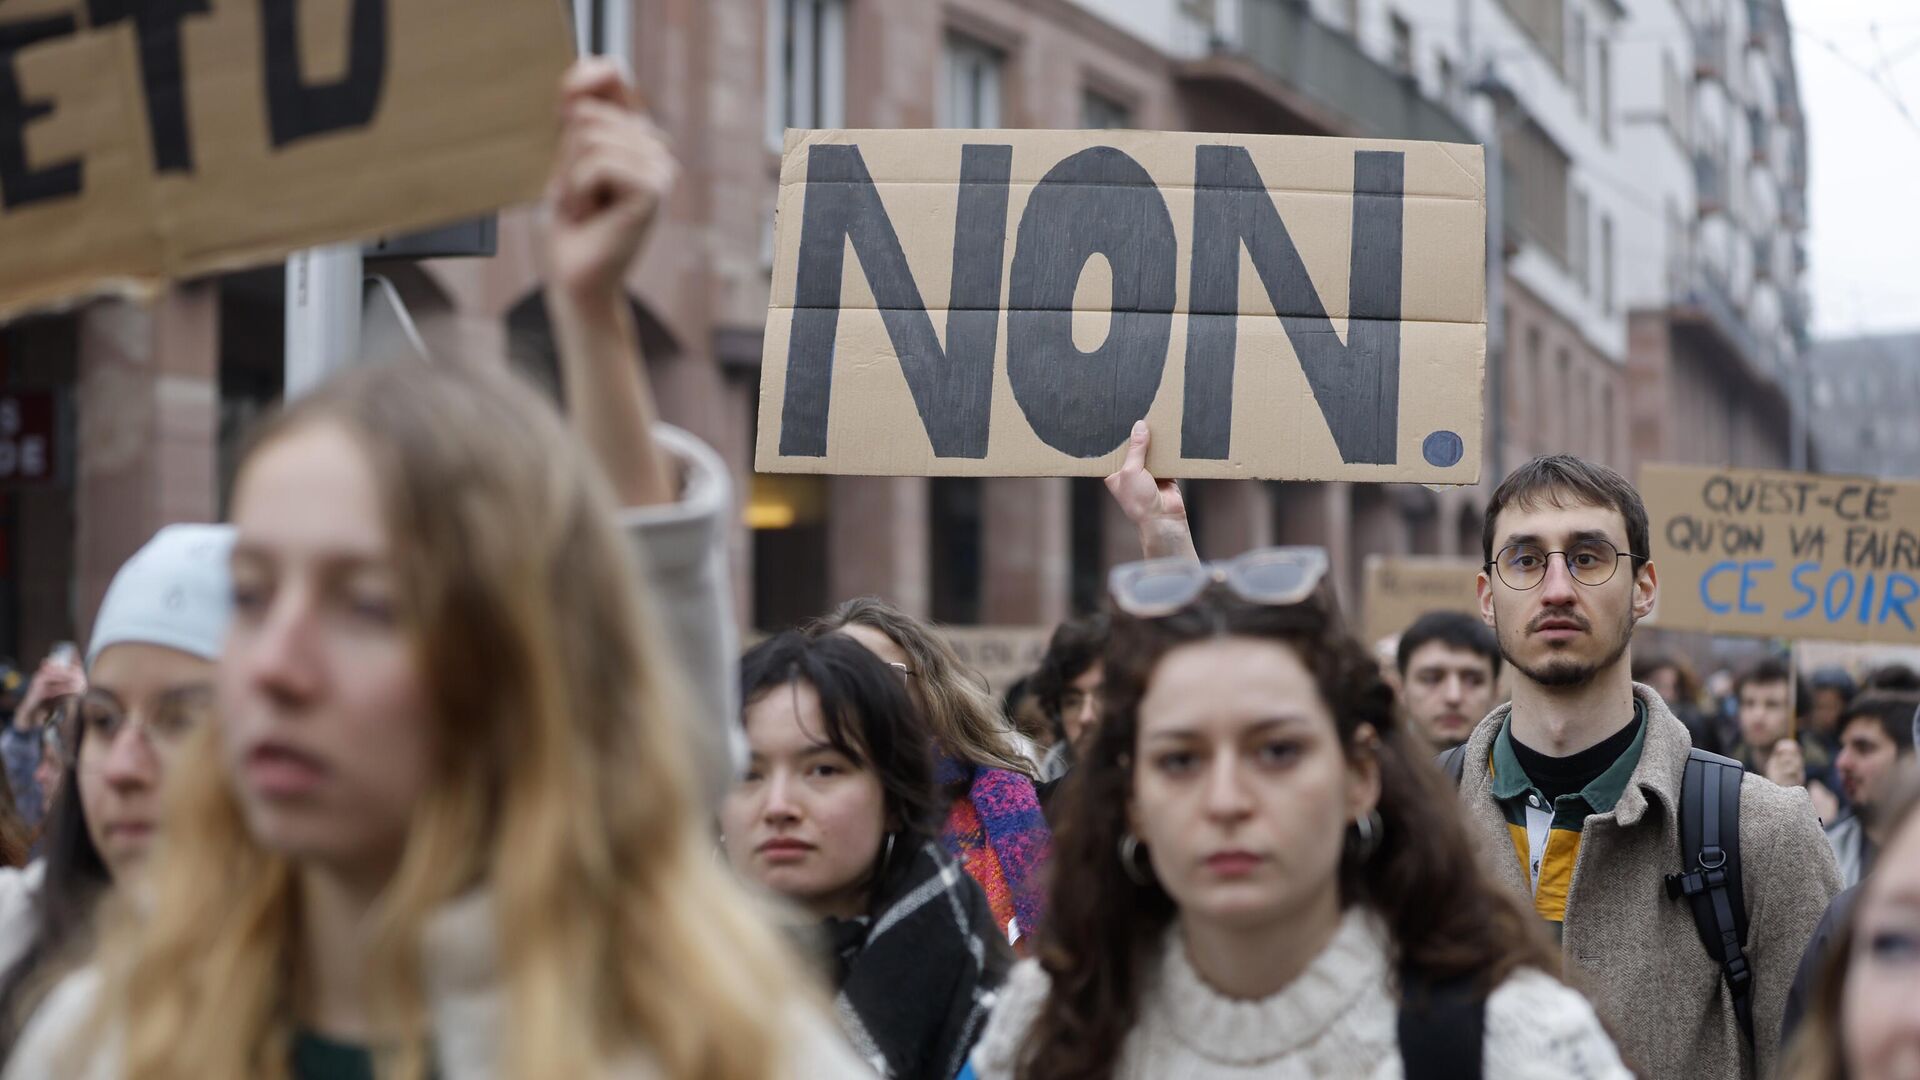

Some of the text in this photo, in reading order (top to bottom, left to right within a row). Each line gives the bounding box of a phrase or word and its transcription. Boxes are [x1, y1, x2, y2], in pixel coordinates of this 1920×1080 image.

[778, 143, 1464, 467] NON.
[1665, 516, 1920, 570] QU'ON VA FAIR
[1700, 560, 1920, 631] CE SOIR
